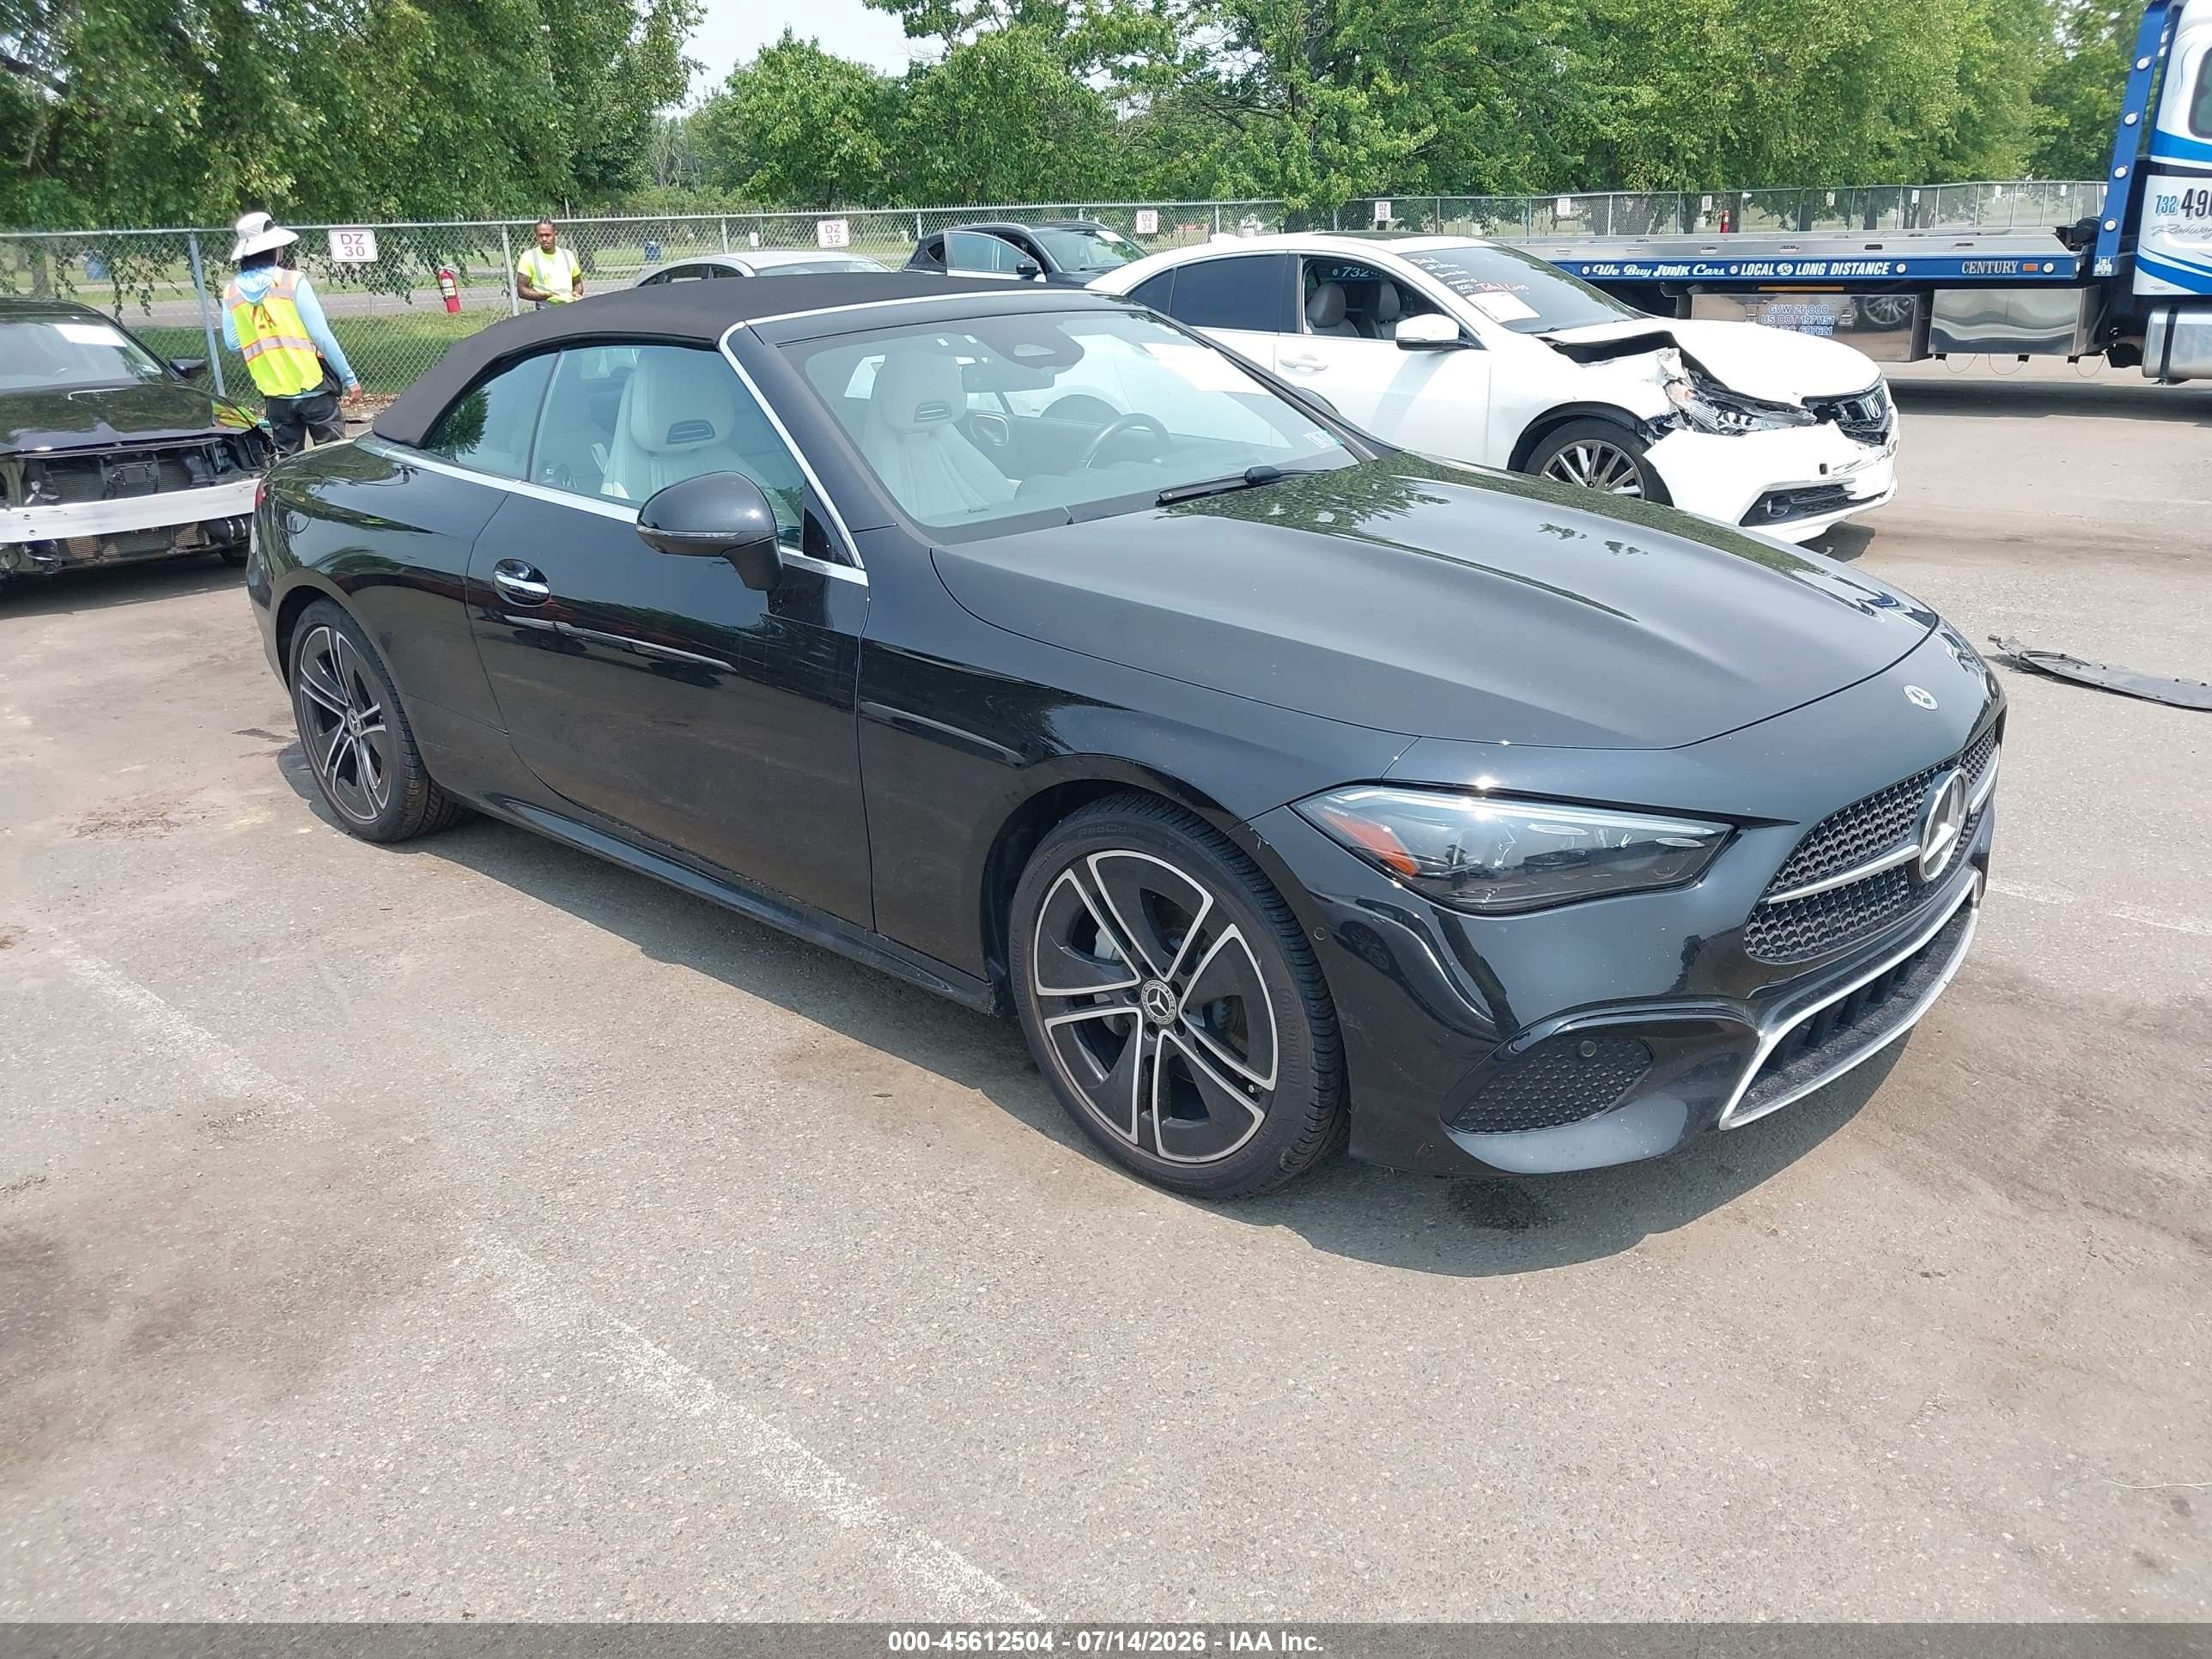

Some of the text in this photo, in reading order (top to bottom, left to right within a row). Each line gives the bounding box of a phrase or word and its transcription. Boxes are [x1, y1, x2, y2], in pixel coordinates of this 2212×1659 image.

[2155, 188, 2212, 218] 732 49
[1141, 214, 1152, 222] DZ
[824, 223, 842, 234] DZ
[1141, 222, 1152, 231] 34
[340, 234, 365, 246] DZ
[826, 234, 842, 245] 32
[343, 246, 366, 258] 30
[1592, 264, 1620, 276] We
[1623, 264, 1653, 278] Buy
[1652, 264, 1691, 277] JUNK
[1692, 264, 1726, 276] Cars
[1740, 263, 1775, 276] LOCAL
[1796, 263, 1827, 276] LONG
[1829, 262, 1892, 276] DISTANCE
[1961, 260, 2019, 275] CENTURY
[1768, 303, 1829, 315] GVW 26,000
[1760, 314, 1776, 325] US
[1778, 314, 1798, 325] DOT
